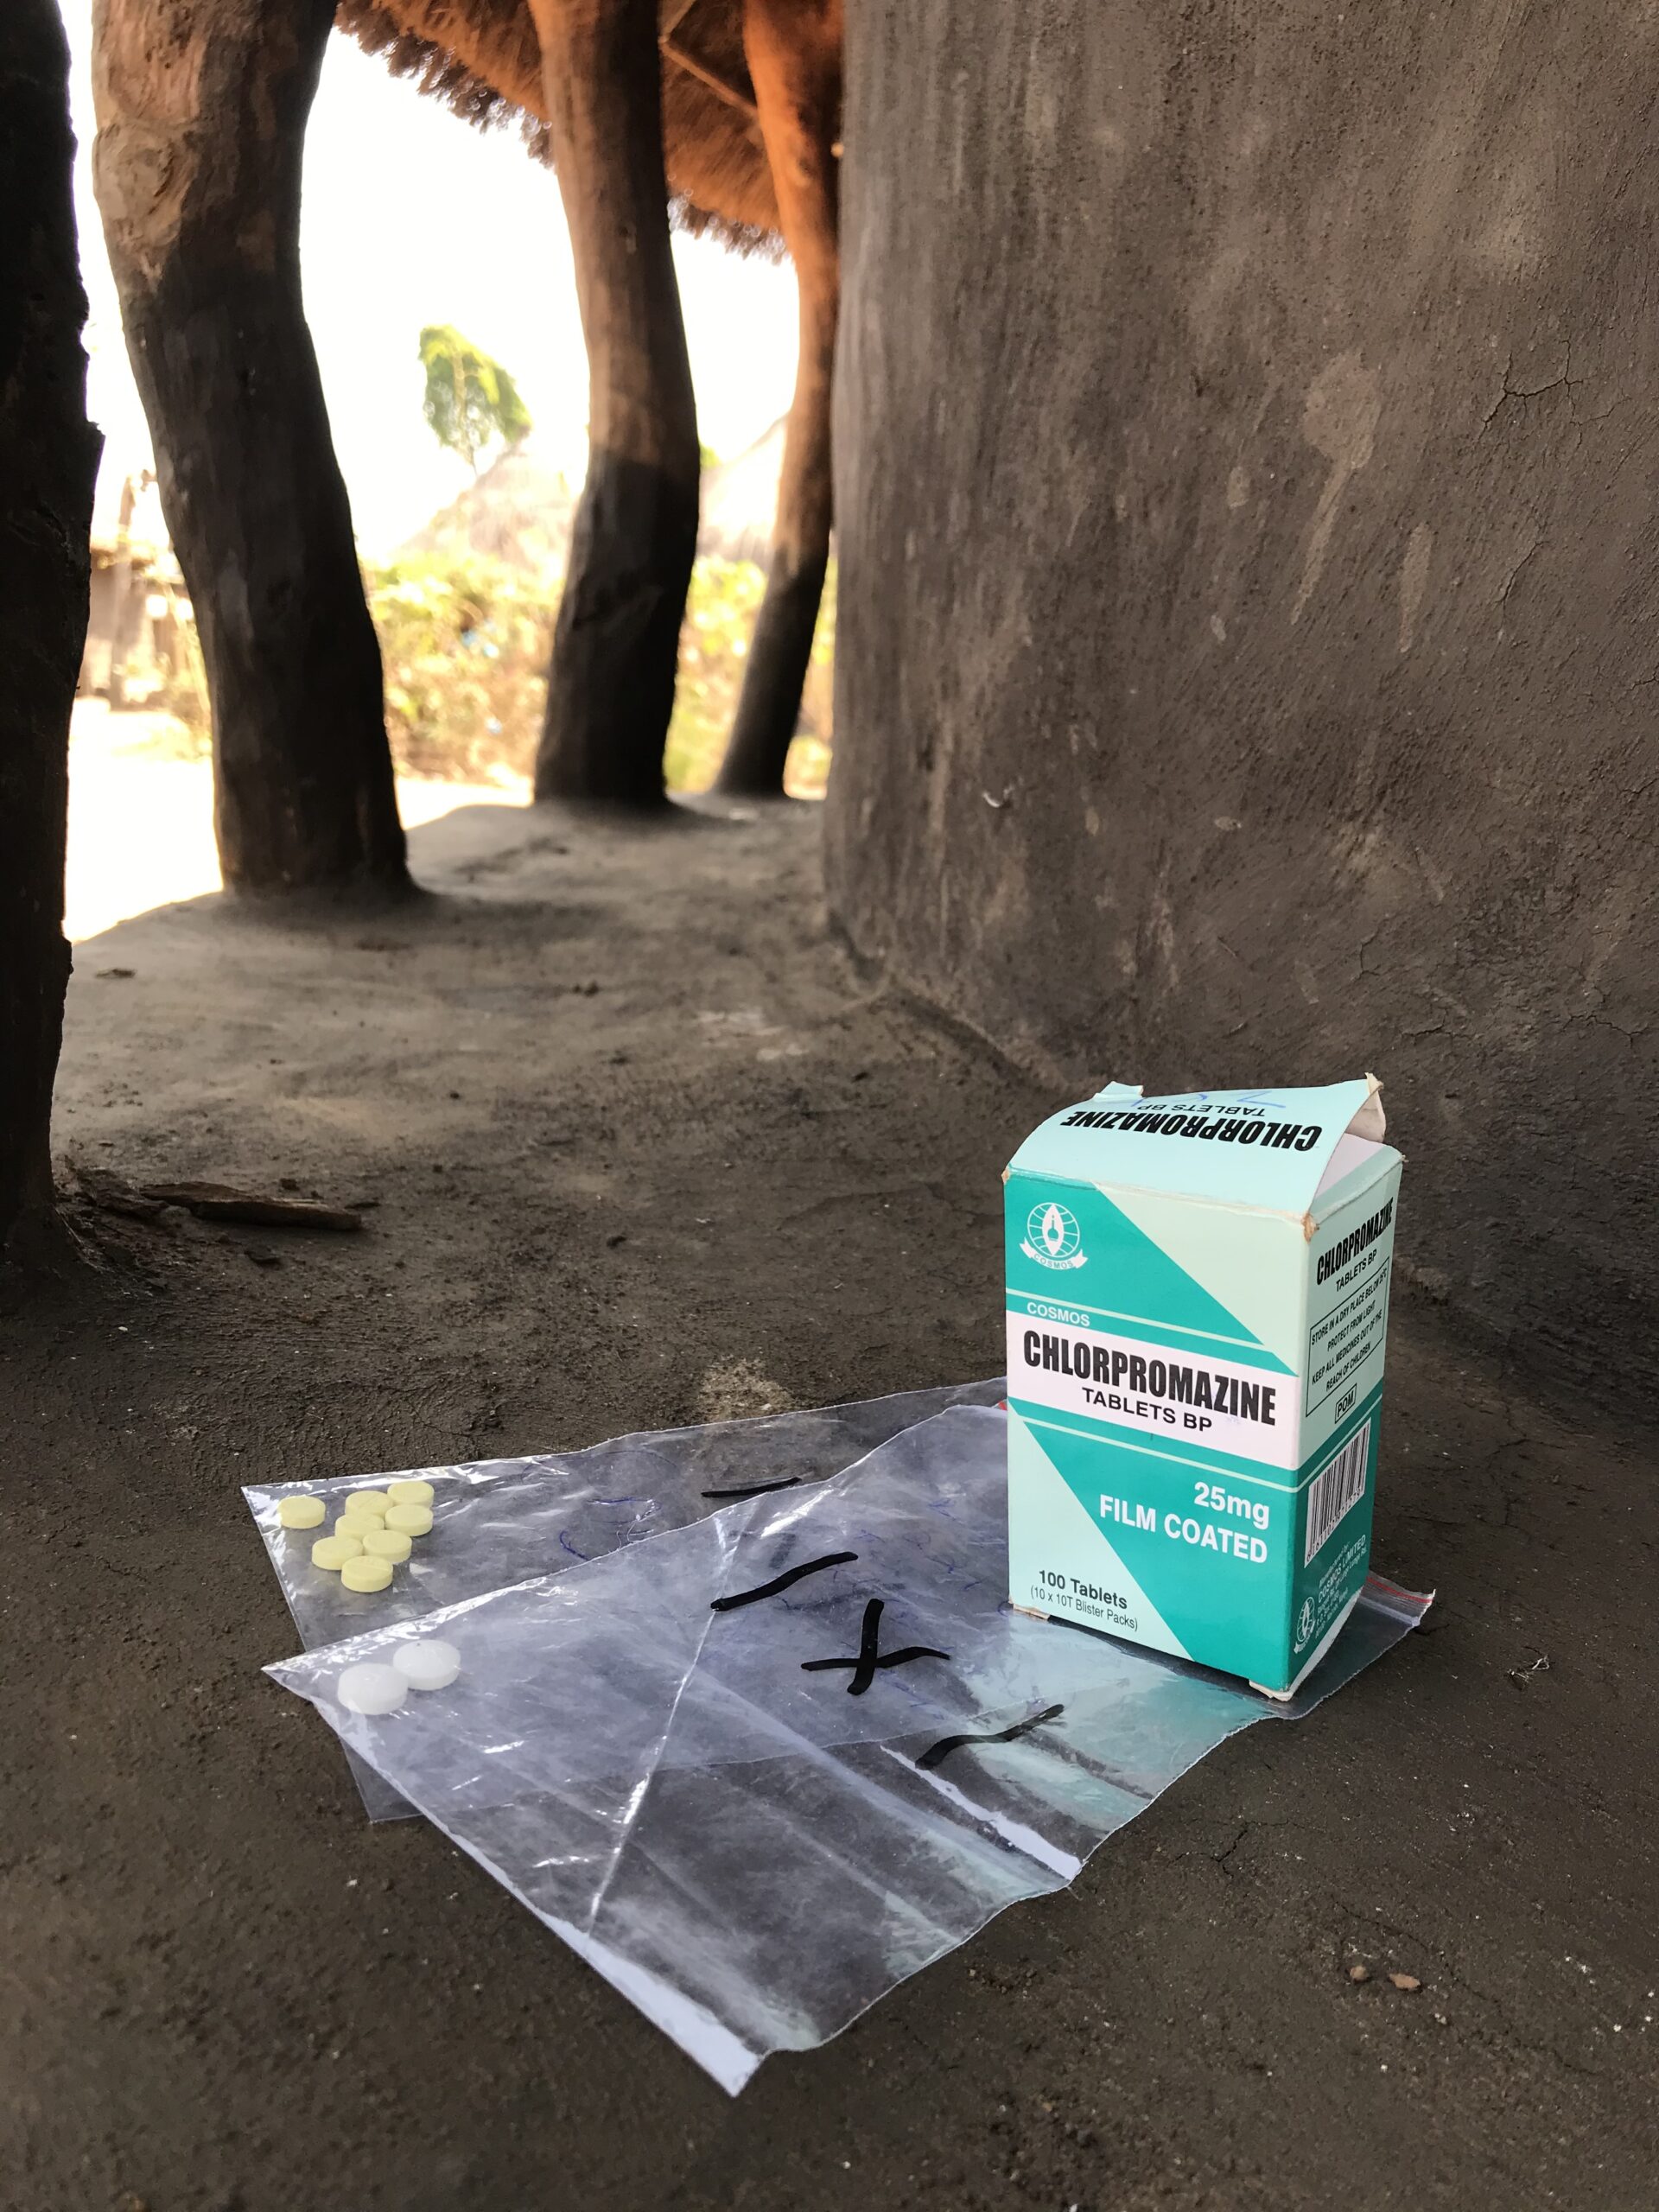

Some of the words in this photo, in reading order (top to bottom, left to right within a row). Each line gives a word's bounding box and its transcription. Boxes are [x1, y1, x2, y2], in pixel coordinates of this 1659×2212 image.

[1059, 1110, 1323, 1152] CHLORPROMAZINE
[1171, 1104, 1266, 1117] TABLETS
[1033, 1253, 1074, 1269] COSMOS
[1316, 1196, 1394, 1286] CHLORPROMAZINE
[1336, 1257, 1367, 1292] TABLETS
[1368, 1249, 1377, 1266] BP
[1027, 1301, 1090, 1327] COSMOS
[1312, 1324, 1329, 1345] STORE
[1329, 1318, 1335, 1331] IN
[1335, 1315, 1339, 1325] A
[1339, 1306, 1350, 1322] DRY
[1350, 1292, 1365, 1313] PLACE
[1365, 1278, 1380, 1299] BELOW
[1327, 1324, 1350, 1351] PROTECT
[1350, 1312, 1363, 1332] FROM
[1312, 1366, 1325, 1385] KEEP
[1325, 1357, 1335, 1373] ALL
[1335, 1333, 1360, 1364] MEDICINES
[1360, 1324, 1370, 1340] OUT
[1326, 1368, 1343, 1392] REACH
[1343, 1362, 1350, 1376] OF
[1350, 1341, 1371, 1369] CHILDREN
[1023, 1330, 1276, 1427] CHLORPROMAZINE
[1082, 1386, 1176, 1424] TABLETS
[1183, 1412, 1212, 1432] BP
[1337, 1389, 1354, 1418] POM
[1193, 1481, 1270, 1530] 25mg
[1100, 1493, 1156, 1533] FILM
[1164, 1513, 1268, 1564] COATED
[1342, 1534, 1366, 1568] LIMITED
[1031, 1585, 1046, 1599] (10
[1047, 1592, 1053, 1603] x
[1056, 1593, 1073, 1608] 10T
[1076, 1599, 1104, 1618] Blister
[1107, 1608, 1138, 1632] Packs)
[1039, 1569, 1065, 1590] 100
[1070, 1578, 1128, 1609] Tablets
